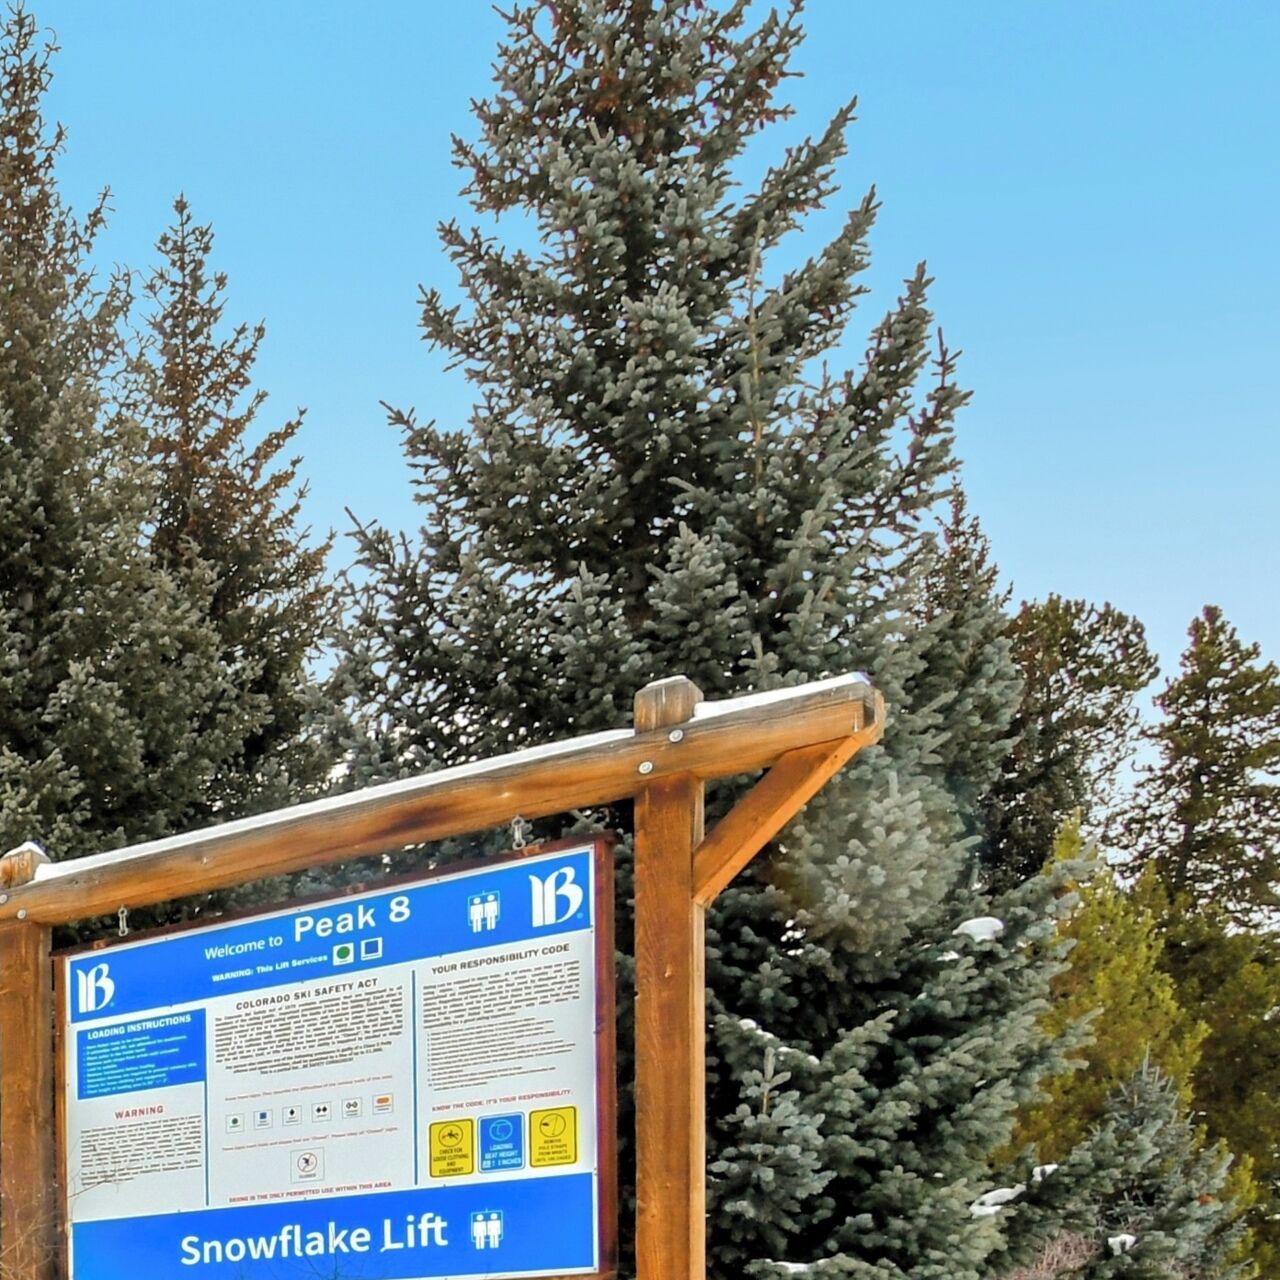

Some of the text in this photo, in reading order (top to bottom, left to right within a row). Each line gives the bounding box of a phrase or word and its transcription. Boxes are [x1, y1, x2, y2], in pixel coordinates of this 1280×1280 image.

[204, 896, 411, 961] Welcome to Peak 8
[212, 954, 328, 983] WARNING: This Lift Services
[432, 943, 571, 975] YOUR RESPONSIBILITY CODE
[236, 978, 378, 1011] COLORADO SKI SAFETY ACT
[87, 1014, 192, 1040] LOADING INSTRUCTIONS
[115, 1105, 164, 1119] WARNING
[269, 1192, 285, 1200] ONLY
[286, 1189, 320, 1197] PERMITTED
[374, 1181, 392, 1189] AREA
[181, 1212, 449, 1266] Snowflake Lift
